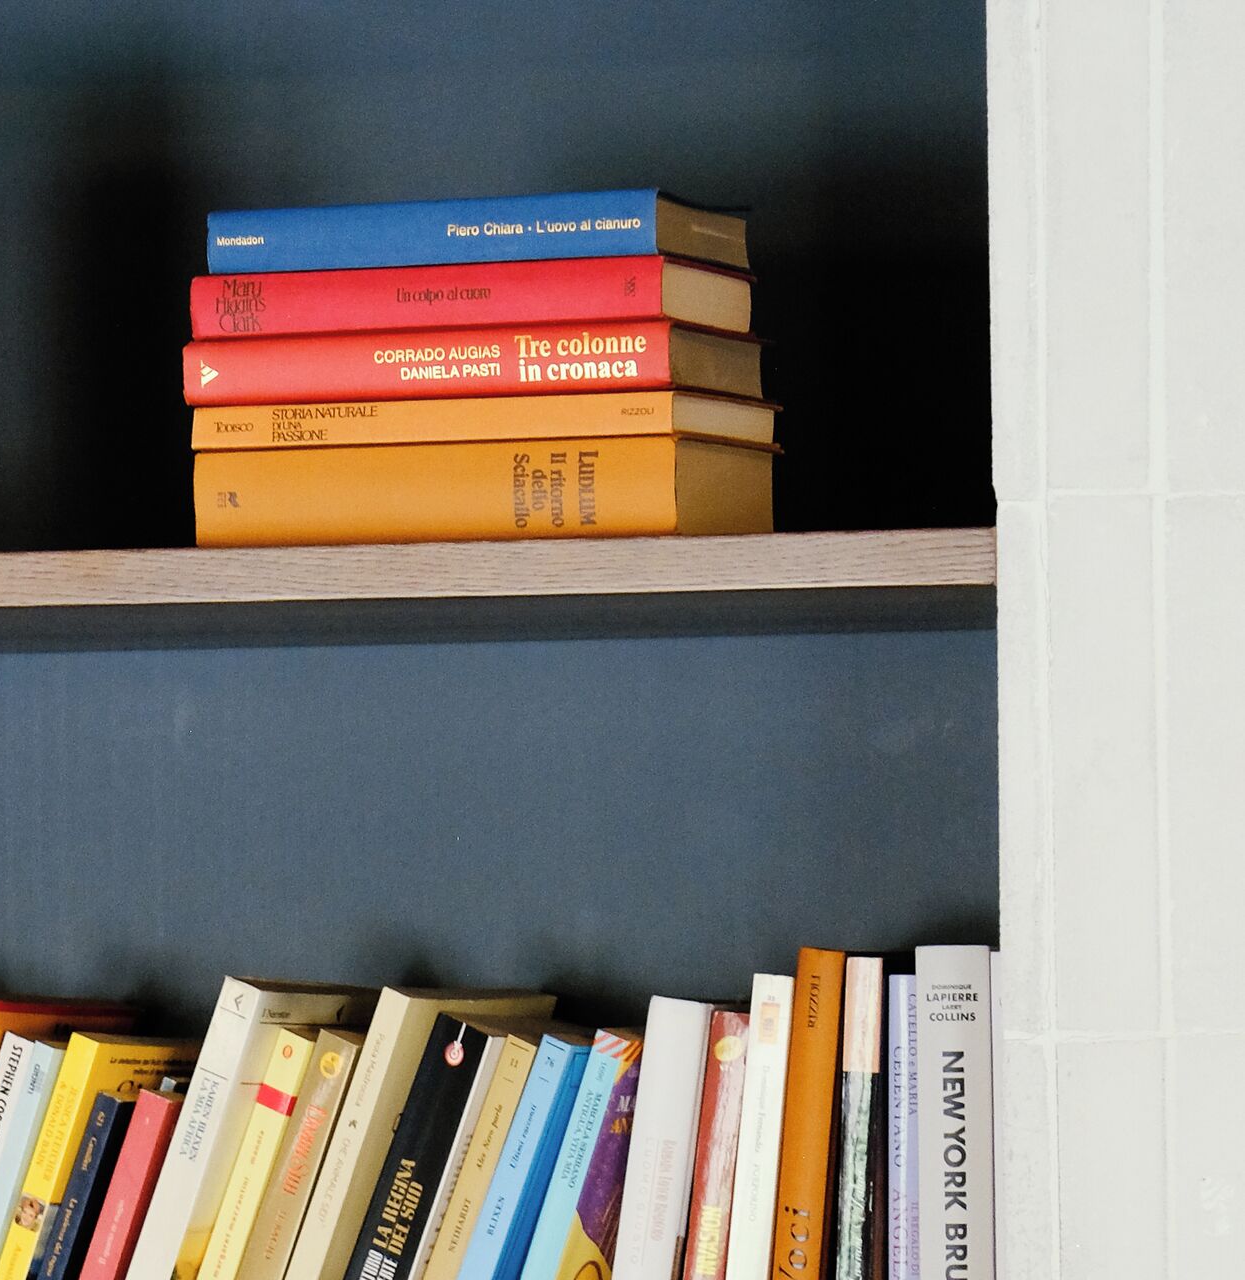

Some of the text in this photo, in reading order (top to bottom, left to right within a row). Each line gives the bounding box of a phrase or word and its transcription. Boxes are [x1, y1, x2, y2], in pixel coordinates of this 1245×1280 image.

[447, 217, 641, 237] Piero Chiara L'uovo al cianuro
[223, 279, 263, 299] Mary
[412, 286, 458, 305] colpo al
[374, 344, 501, 364] CORRADO AUGIAS
[515, 331, 647, 358] Tre colonne
[400, 362, 501, 381] DANIELA PASTI
[518, 358, 638, 383] in cronaca
[271, 405, 378, 420] STORIA NATURALE
[620, 406, 655, 417] RIZZOLI
[271, 430, 328, 442] PASSIONE
[512, 453, 531, 529] Sciacallo
[530, 469, 549, 511] dello
[549, 469, 567, 528] ritorno
[807, 974, 820, 1027] RIZZOLI
[925, 992, 979, 1003] LAPIERRE
[929, 1011, 976, 1023] COLLINS
[907, 993, 916, 1056] CATELLO
[0, 1045, 22, 1095] STEPHEN
[908, 1071, 917, 1115] MARIA
[942, 1050, 965, 1120] NEW
[35, 1093, 64, 1166] DONALD BAIN
[42, 1086, 77, 1180] JESSICA FLETCHER
[179, 1076, 210, 1155] LA MIA AFRICA
[188, 1080, 219, 1161] KAREN BLIXEN
[581, 1093, 602, 1139] MARCELA
[560, 1136, 579, 1180] VITA MIA
[567, 1141, 587, 1188] SERRANO
[943, 1126, 966, 1210] YORK
[372, 1158, 415, 1248] LA REGINA
[486, 1139, 524, 1235] BLIXEN Ultimi
[387, 1180, 423, 1254] DEL SUD
[695, 1204, 723, 1275] INVASION
[910, 1201, 918, 1275] IL REGALO DI
